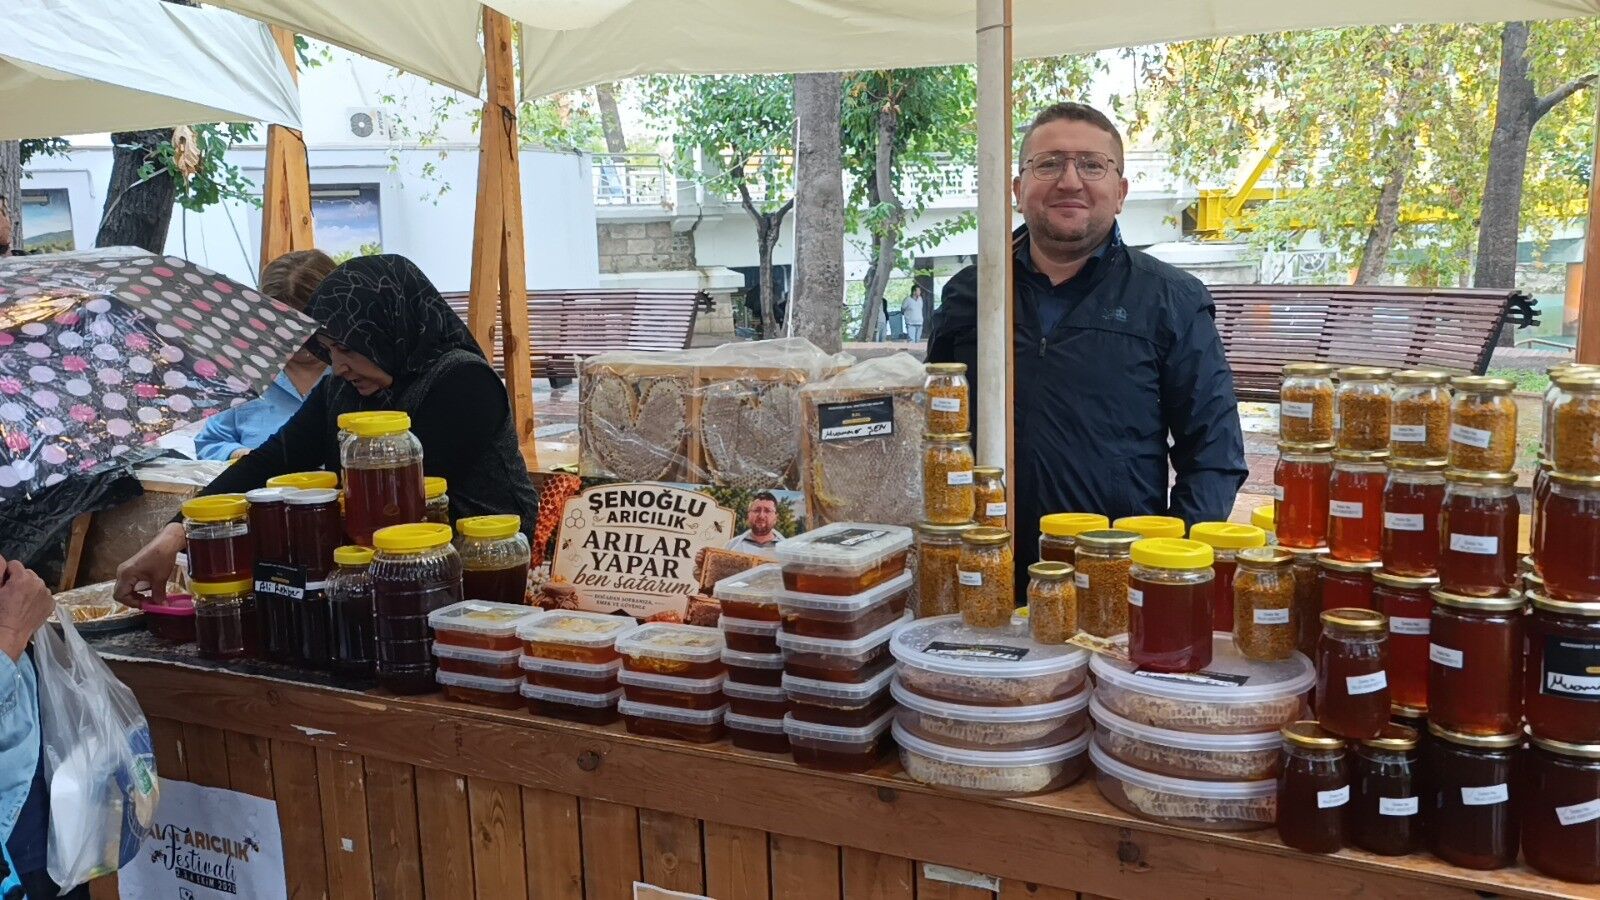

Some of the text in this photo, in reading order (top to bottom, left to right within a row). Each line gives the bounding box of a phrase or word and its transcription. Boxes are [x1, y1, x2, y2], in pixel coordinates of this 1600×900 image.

[588, 489, 707, 517] ŞENOĞLU
[606, 511, 687, 530] ARICILIK
[582, 530, 692, 559] ARILAR
[590, 551, 679, 579] YAPAR
[573, 564, 694, 596] ben satarım
[162, 824, 237, 883] Festivali
[183, 831, 250, 863] ARICILIK
